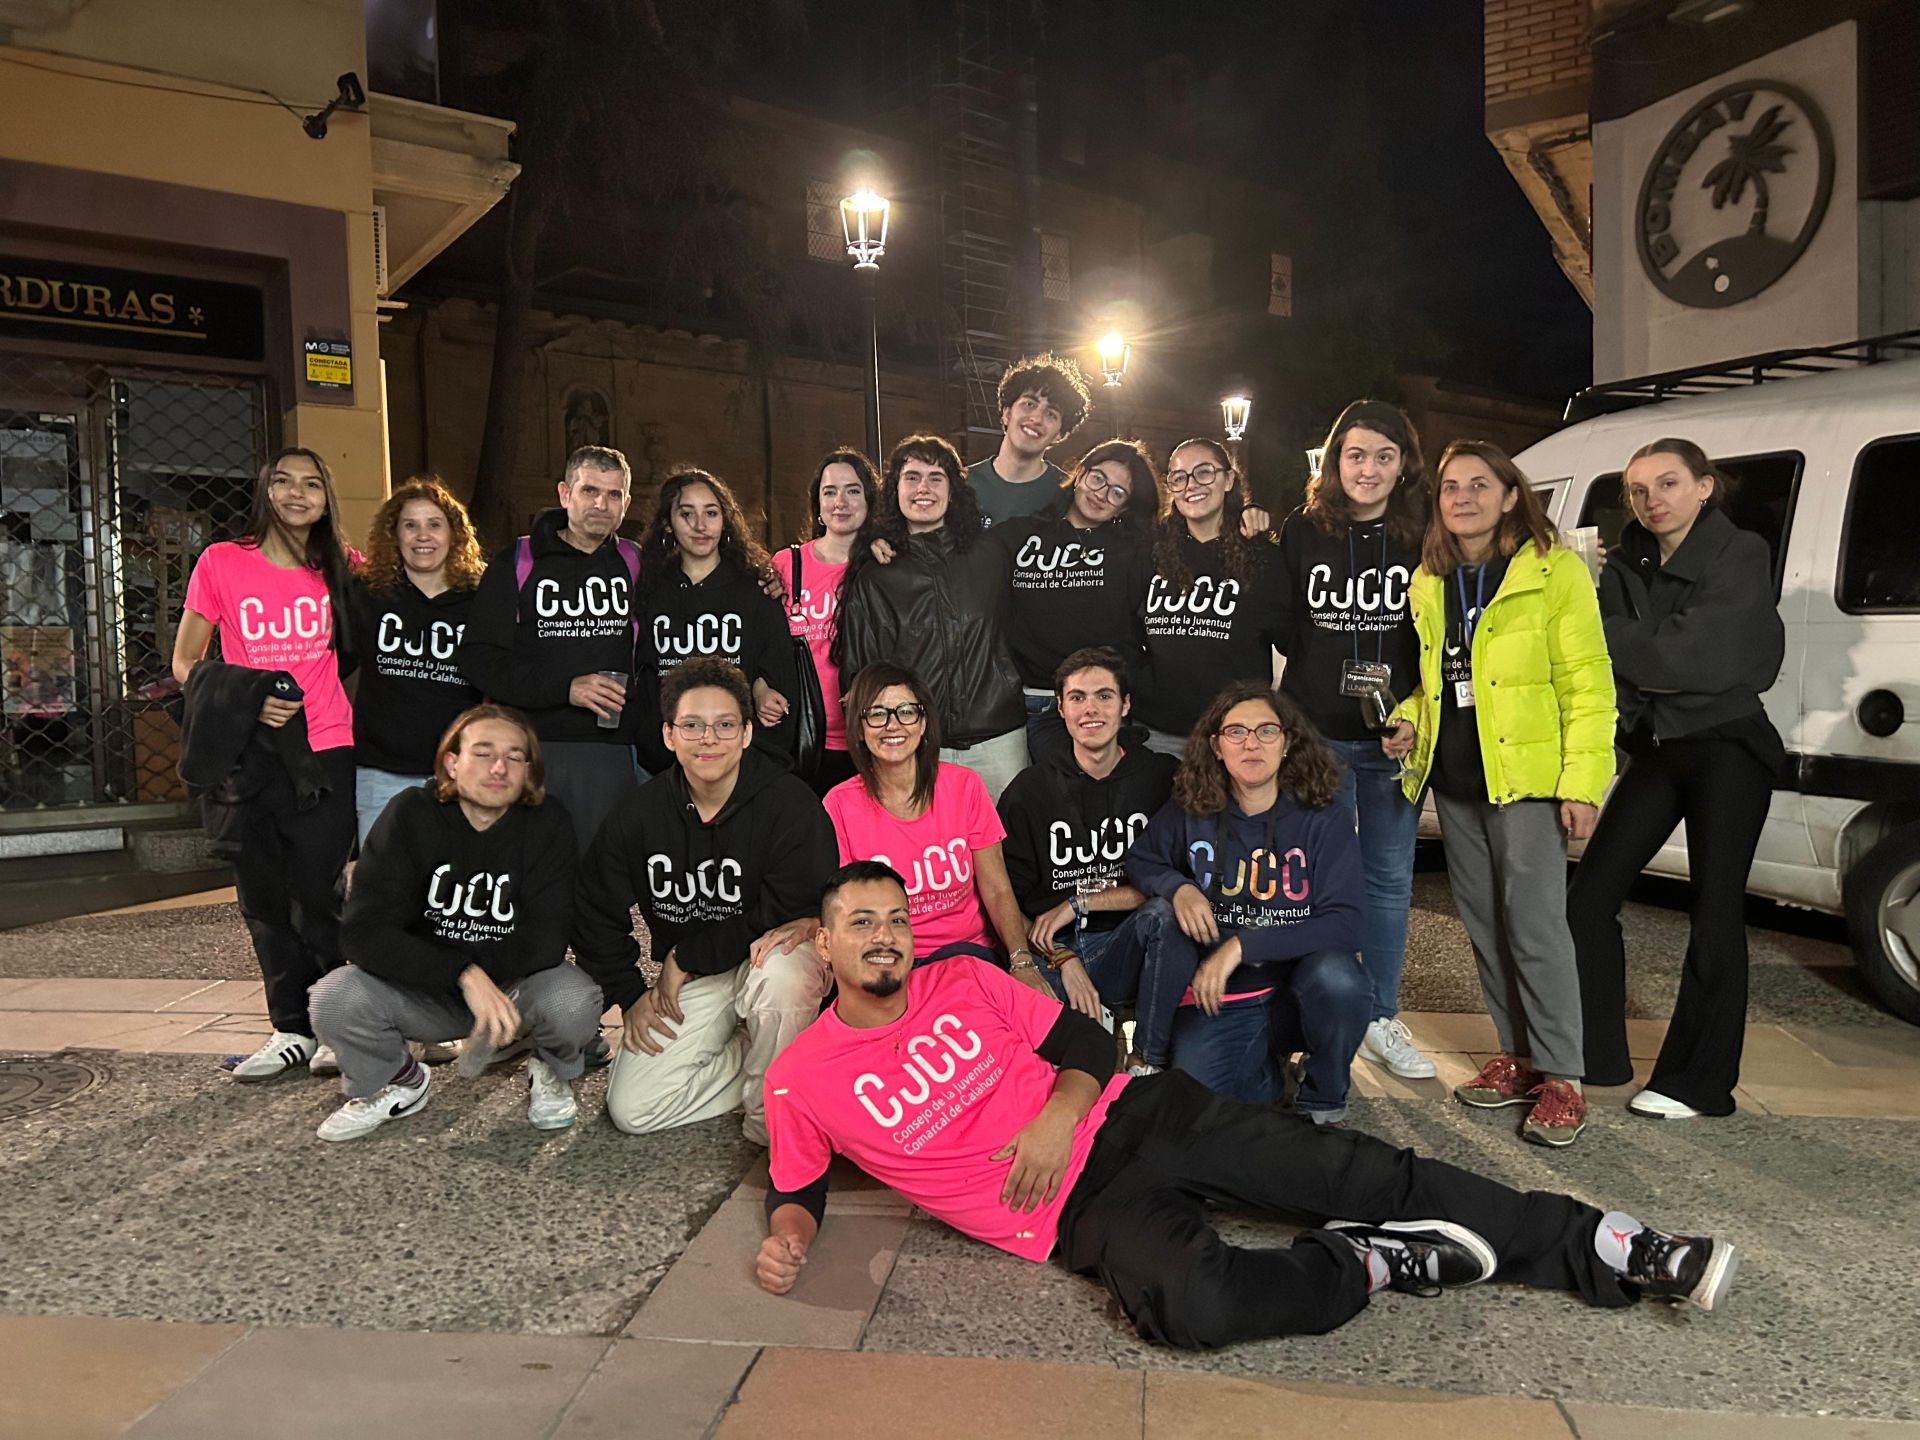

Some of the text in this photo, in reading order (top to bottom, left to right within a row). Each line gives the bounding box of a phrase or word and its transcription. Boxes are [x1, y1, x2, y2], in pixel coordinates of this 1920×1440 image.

[1042, 569, 1054, 579] de
[1055, 568, 1064, 579] la
[1065, 567, 1104, 579] Juventud
[1049, 579, 1060, 589] de
[1061, 578, 1104, 588] Calahorra
[1307, 563, 1410, 612] CJCC
[535, 576, 630, 618] CJCC
[537, 619, 573, 629] Consejo
[573, 618, 586, 628] de
[586, 617, 596, 628] la
[1170, 614, 1182, 625] de
[1182, 614, 1192, 626] la
[1191, 615, 1233, 630] Juventud
[1338, 610, 1351, 621] de
[1352, 611, 1361, 621] la
[1363, 610, 1405, 622] Juventud
[537, 627, 580, 638] Comarcal
[580, 627, 592, 638] de
[1175, 625, 1187, 636] de
[1187, 626, 1231, 640] Calahorra
[1344, 620, 1357, 632] de
[653, 612, 743, 655] CJCC
[376, 654, 411, 668] Consejo
[412, 657, 424, 669] de
[425, 659, 434, 670] la
[1451, 658, 1463, 669] de
[377, 664, 417, 677] Comarcal
[417, 669, 430, 680] de
[1051, 867, 1086, 880] Consejo
[1099, 863, 1108, 874] la
[913, 894, 925, 904] de
[927, 891, 936, 901] la
[921, 902, 933, 914] de
[1246, 904, 1257, 916] la
[1260, 904, 1311, 918] Juventud
[441, 918, 515, 934] de la Juventud
[1236, 914, 1252, 926] de
[447, 930, 461, 939] de
[853, 1013, 982, 1128] CJCC
[892, 1051, 996, 1145] Consejo de la Juventud
[903, 1066, 1004, 1156] Comarcal de Calahorra
